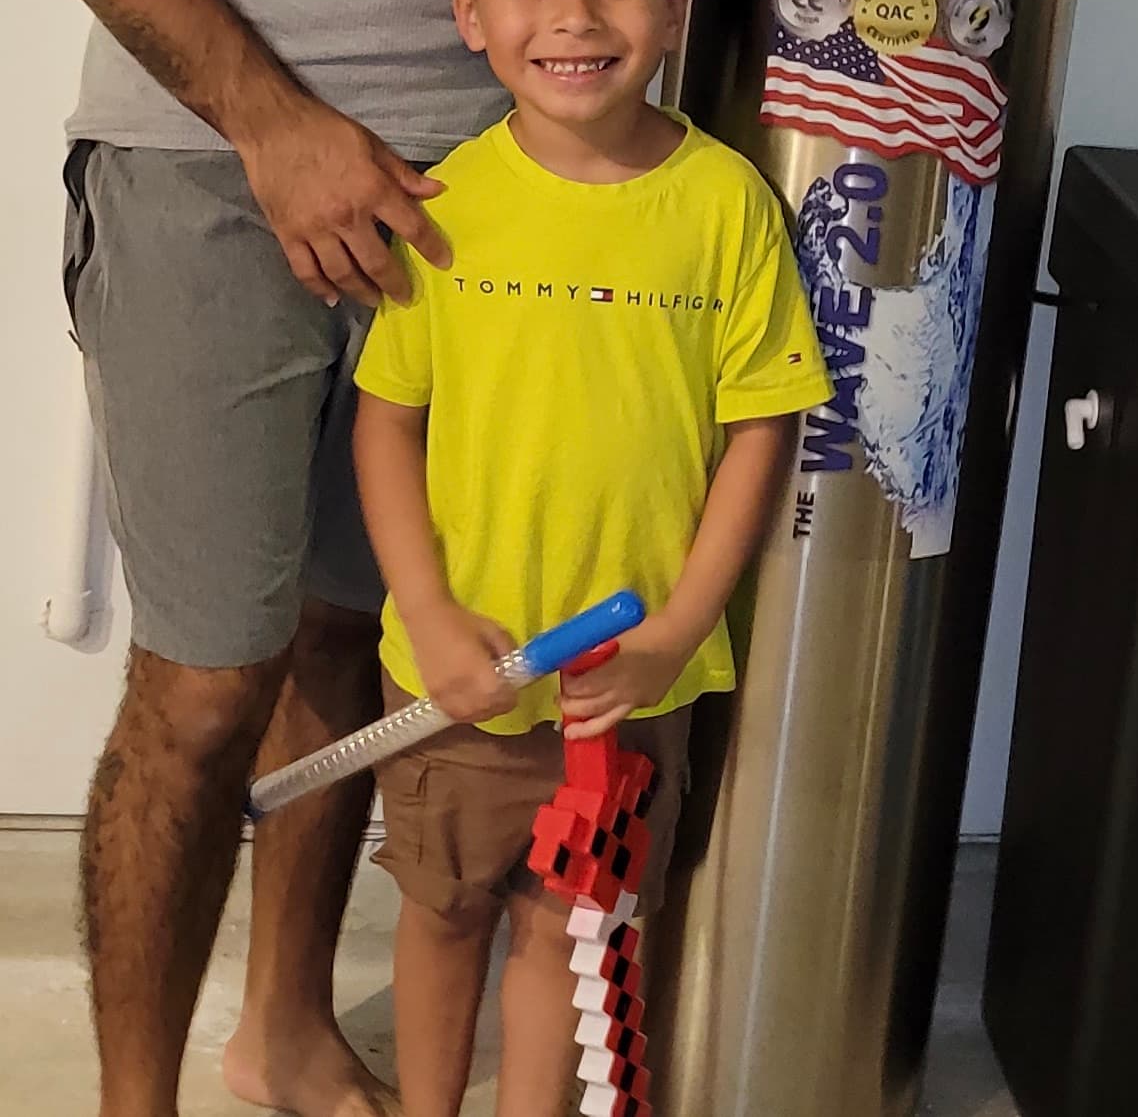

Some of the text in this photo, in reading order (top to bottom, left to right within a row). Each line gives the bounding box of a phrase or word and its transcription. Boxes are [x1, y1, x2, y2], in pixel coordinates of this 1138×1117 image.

[876, 3, 915, 20] QAC
[866, 25, 920, 47] CERTIFIED
[454, 278, 724, 313] TOMMY HILFIGR
[793, 162, 888, 539] THE WAVE 2.0
